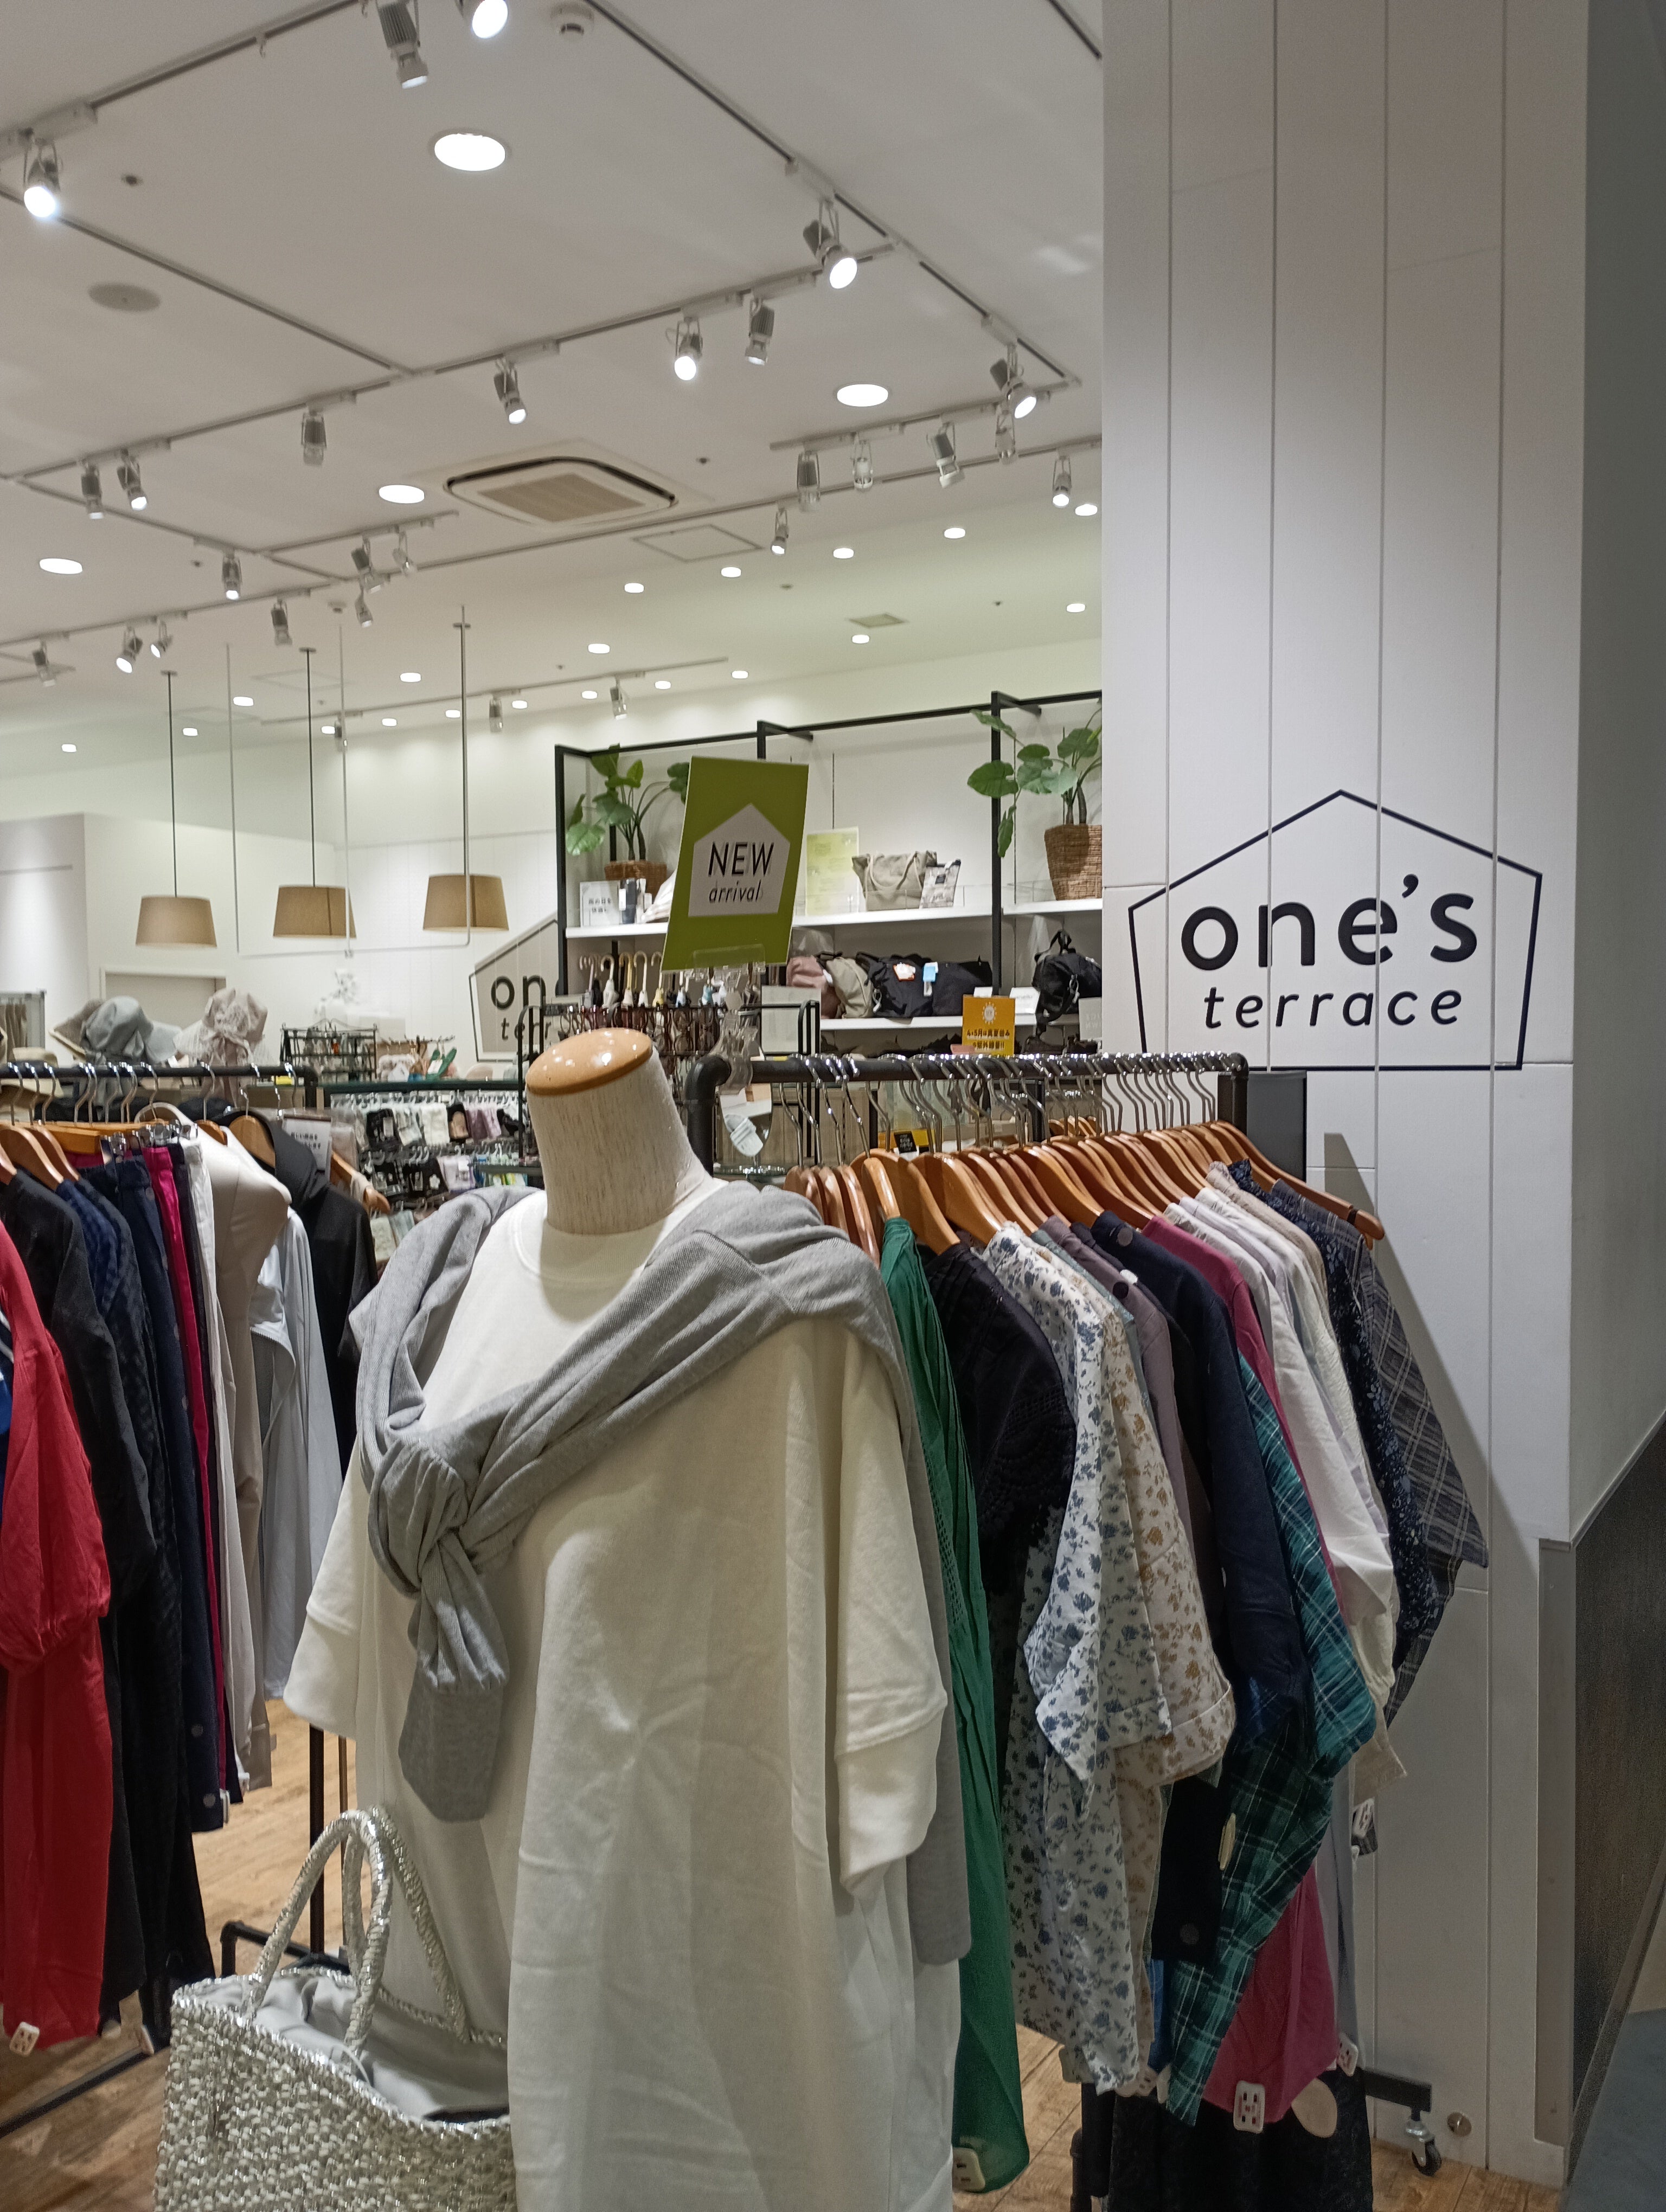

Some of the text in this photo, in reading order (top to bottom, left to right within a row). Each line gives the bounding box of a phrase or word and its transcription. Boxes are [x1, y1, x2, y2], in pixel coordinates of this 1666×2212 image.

[708, 841, 774, 877] NEW
[708, 879, 762, 904] arrival
[1181, 874, 1478, 971] one's
[491, 975, 559, 1009] on
[1203, 987, 1462, 1029] terrace
